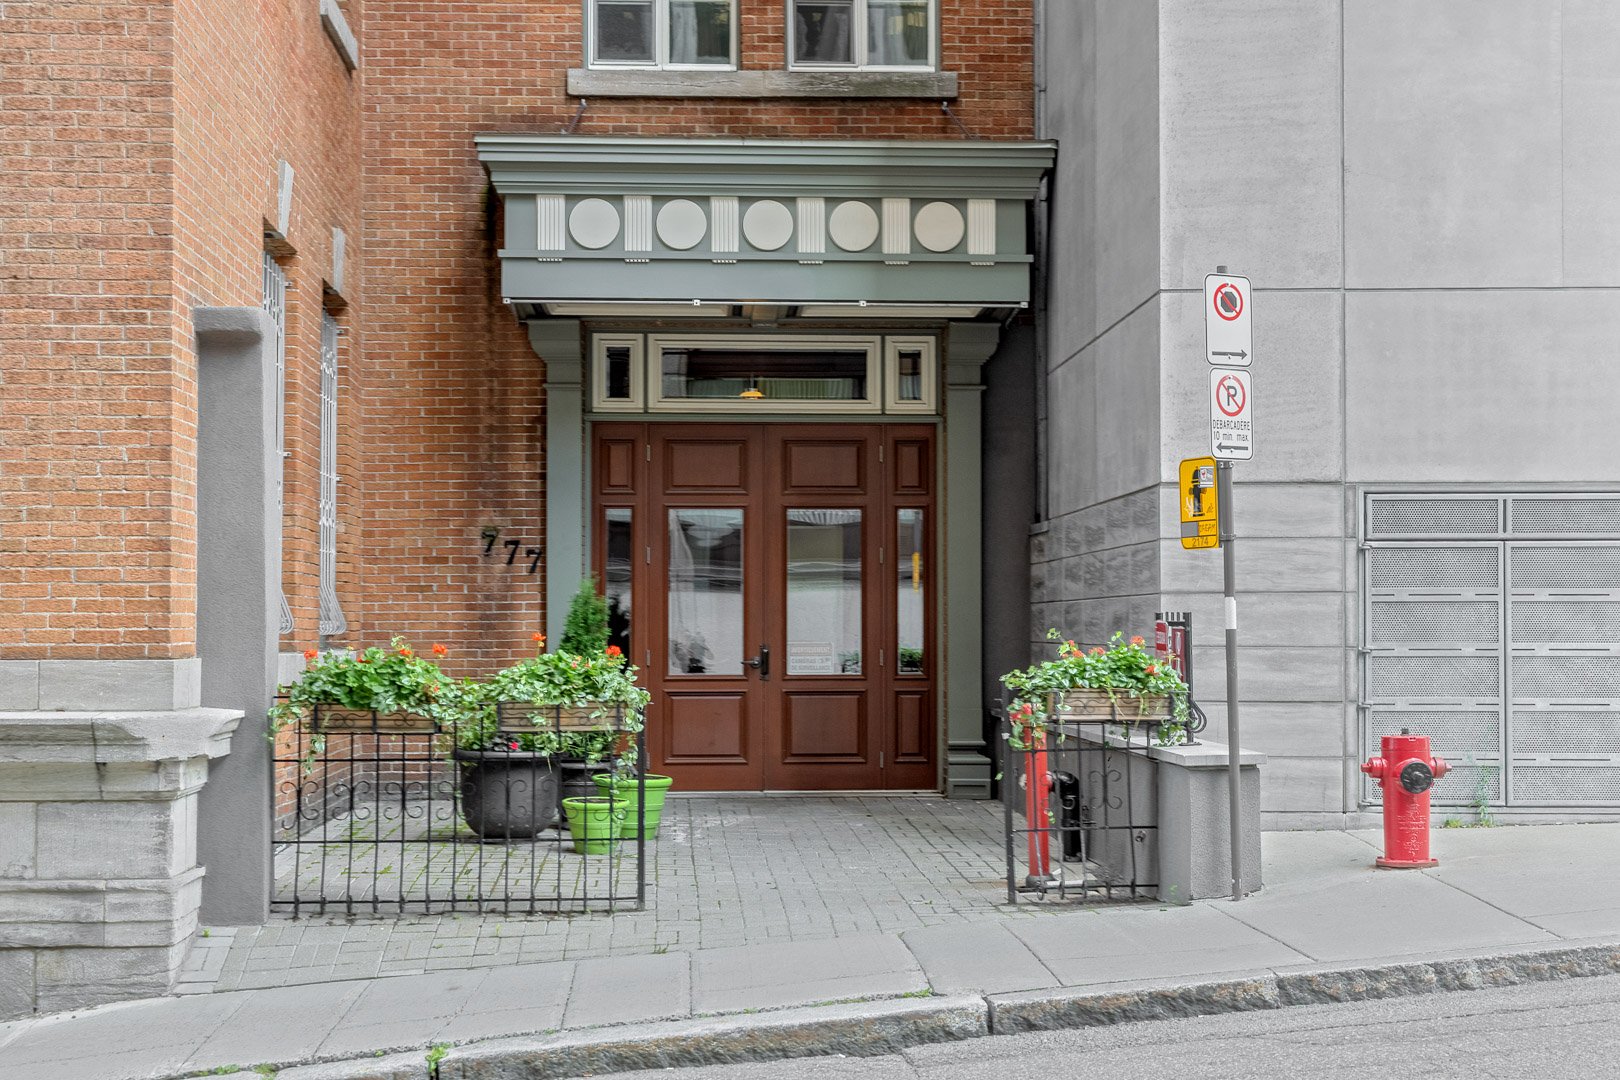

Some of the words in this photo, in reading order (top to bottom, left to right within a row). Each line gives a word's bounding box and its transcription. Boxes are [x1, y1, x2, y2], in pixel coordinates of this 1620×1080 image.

[1213, 431, 1220, 441] 10
[1191, 537, 1209, 547] 2174
[481, 531, 542, 574] 777
